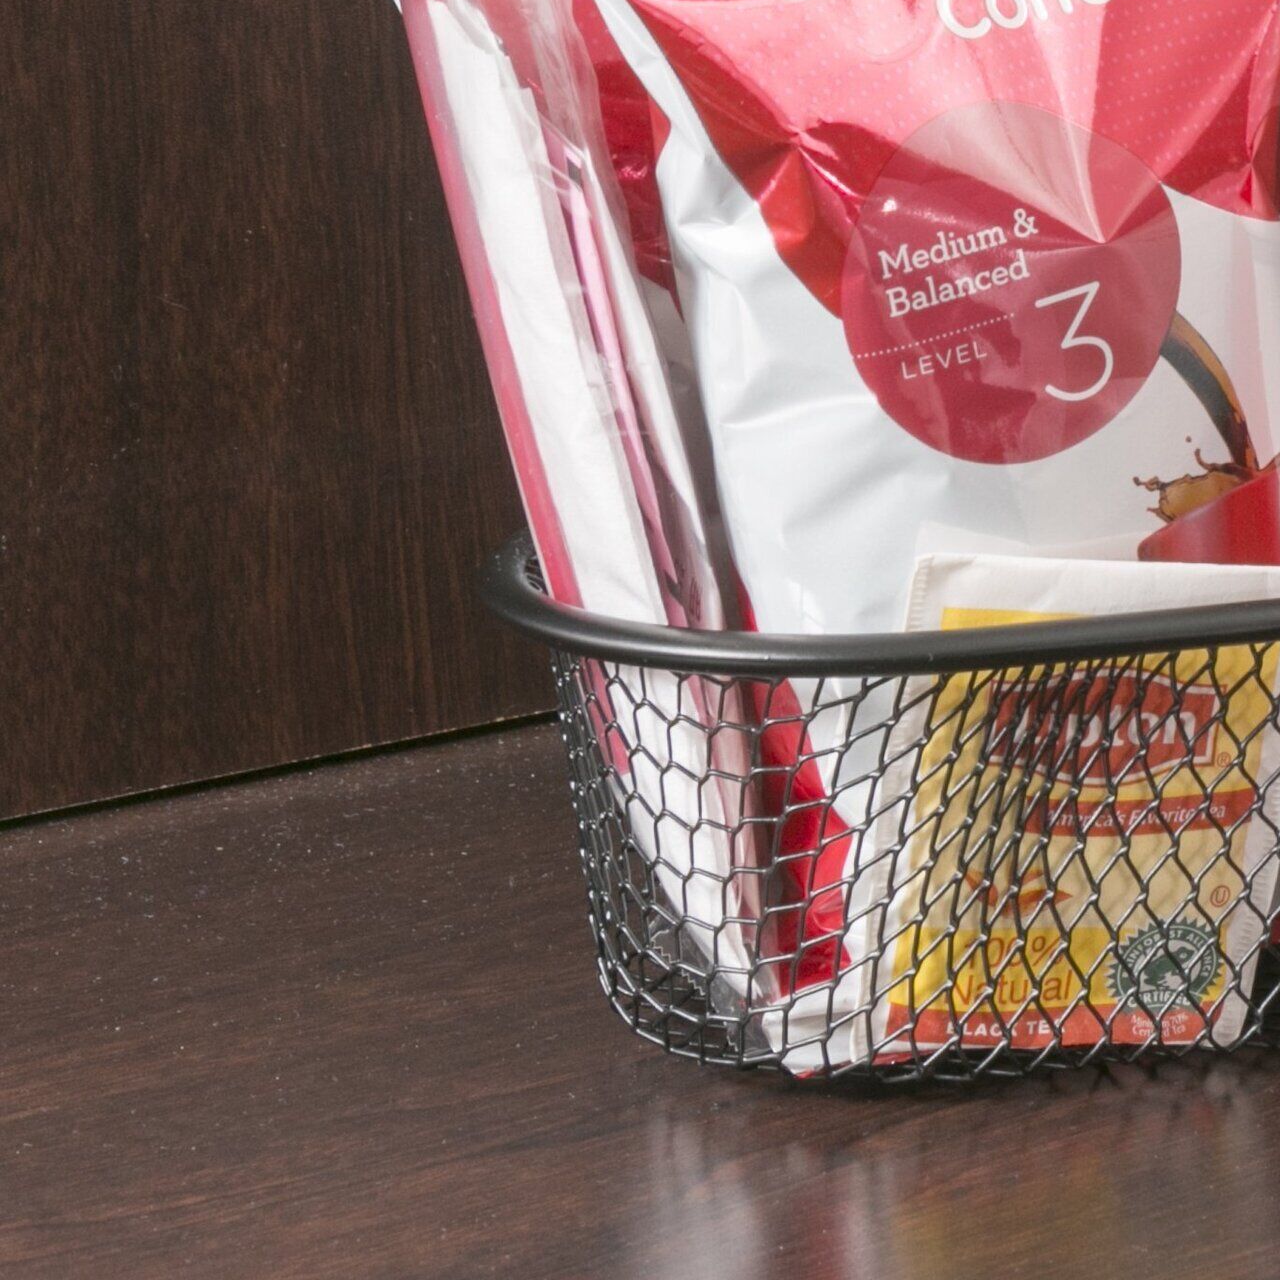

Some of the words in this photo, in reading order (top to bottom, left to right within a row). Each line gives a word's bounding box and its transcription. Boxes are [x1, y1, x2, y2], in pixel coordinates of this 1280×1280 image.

[878, 225, 1007, 279] Medium
[1013, 208, 1038, 238] &
[885, 249, 1030, 317] Balanced
[901, 341, 987, 379] LEVEL
[1035, 281, 1114, 401] 3
[1198, 802, 1226, 820] ea
[944, 970, 1073, 1005] Natual
[1127, 990, 1192, 1008] CRTIFED
